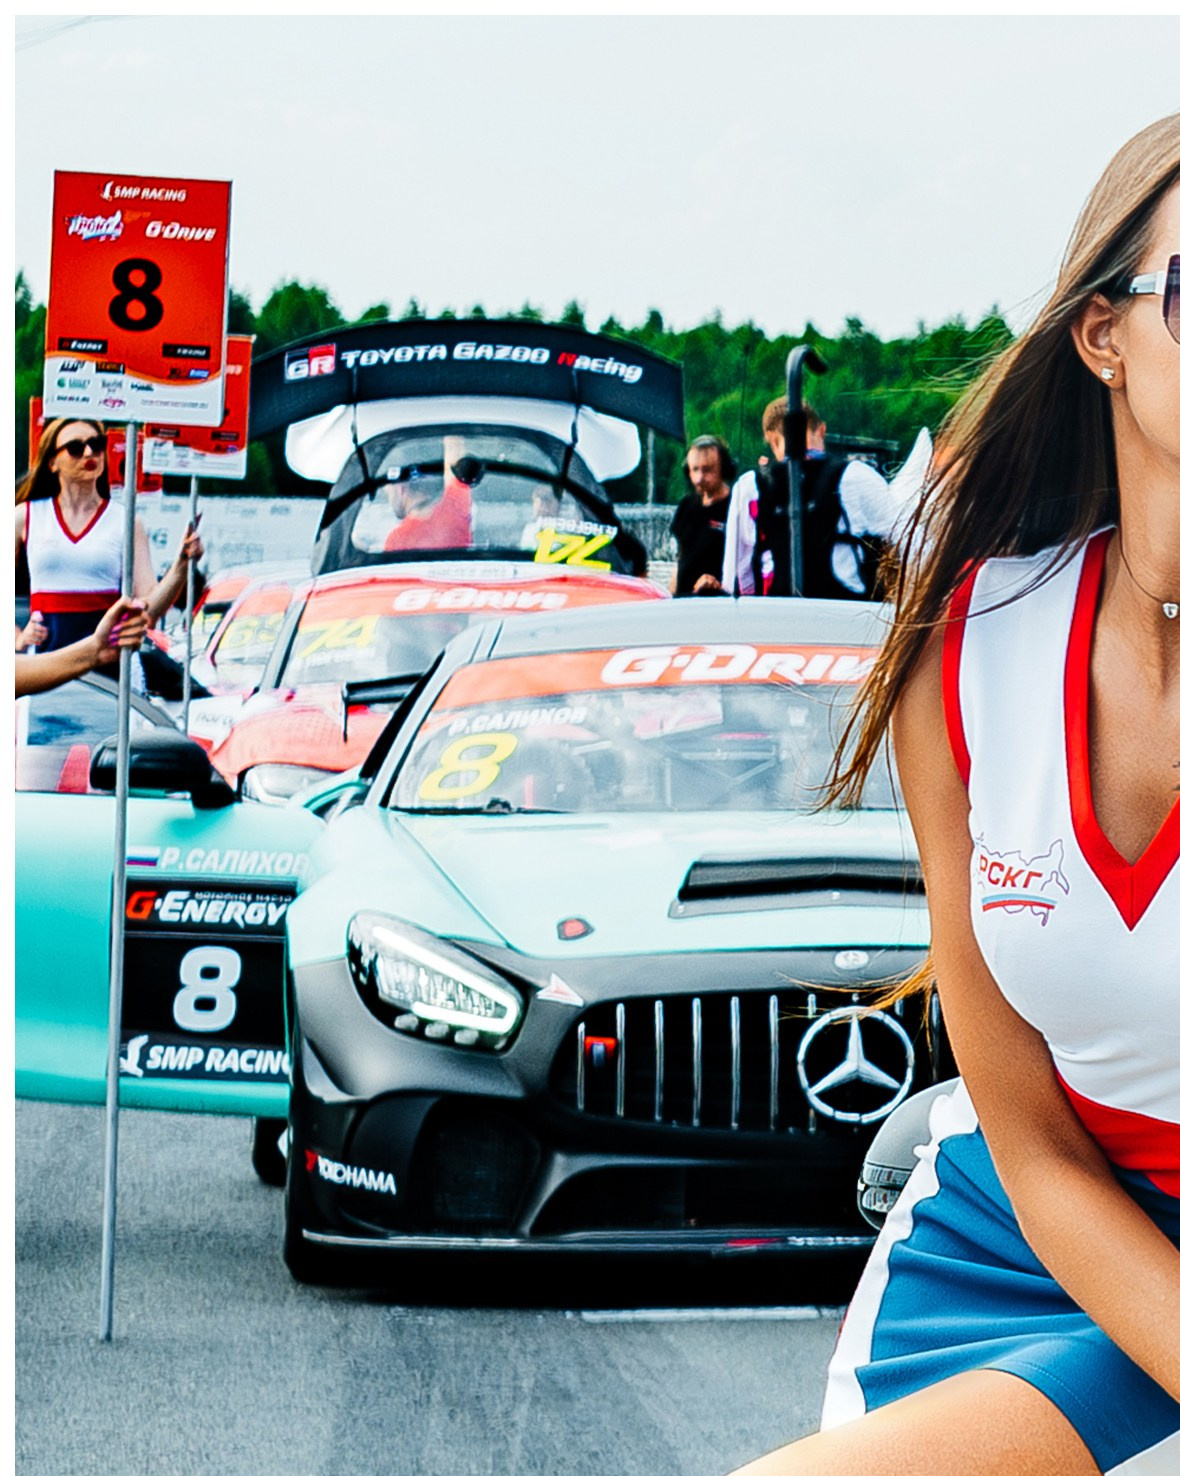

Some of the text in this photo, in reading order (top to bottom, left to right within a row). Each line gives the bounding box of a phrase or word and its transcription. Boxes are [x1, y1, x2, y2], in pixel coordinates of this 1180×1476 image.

[113, 185, 187, 203] SMP RACING
[108, 257, 164, 333] 8
[288, 354, 334, 380] GR
[340, 344, 447, 369] TOYOTA
[452, 341, 550, 365] GAZOO
[299, 613, 381, 659] 74
[416, 732, 519, 802] 8
[172, 944, 243, 1033] 8
[146, 1044, 205, 1071] SMP
